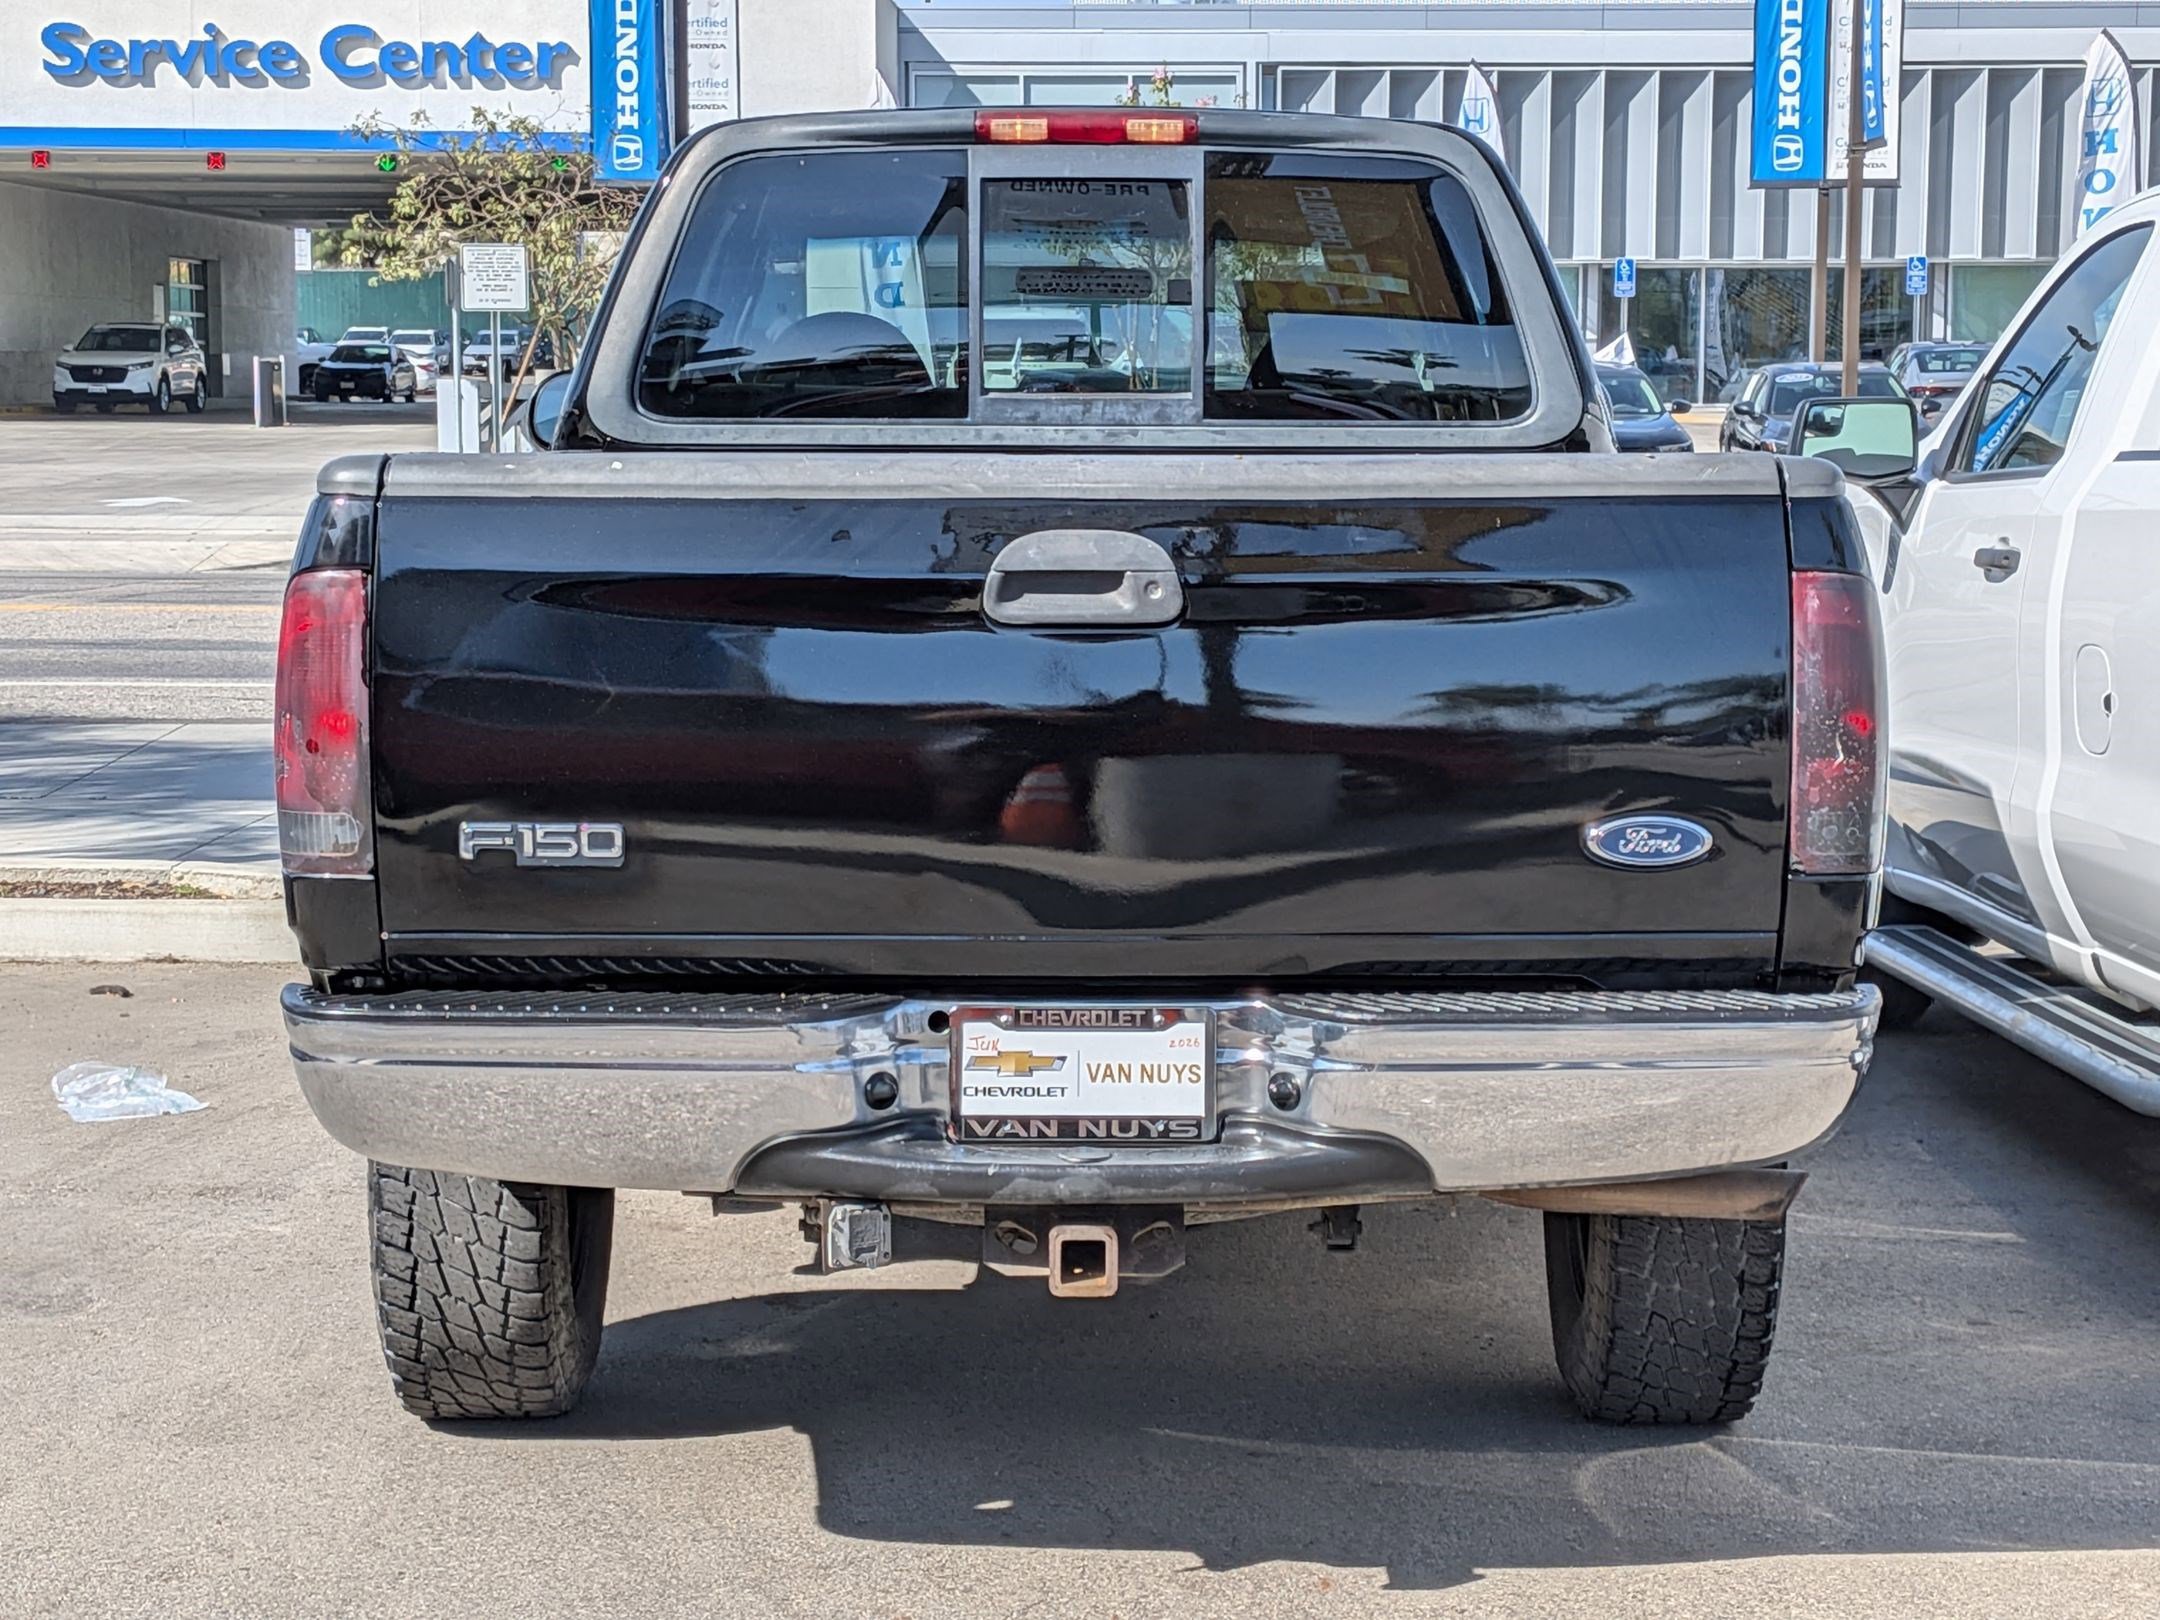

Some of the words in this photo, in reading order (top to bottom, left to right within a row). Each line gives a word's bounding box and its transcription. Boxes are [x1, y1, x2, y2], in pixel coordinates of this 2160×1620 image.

[688, 16, 728, 28] rtified
[40, 21, 300, 79] Service
[319, 23, 567, 80] Center
[688, 77, 729, 89] rtified
[459, 821, 625, 867] F-150
[1618, 827, 1682, 853] Ford
[1018, 1009, 1147, 1027] CHEVROLET
[1168, 1037, 1201, 1049] 2026
[1086, 1062, 1132, 1084] VAN
[1140, 1062, 1201, 1084] NUYS
[963, 1086, 1068, 1098] CHEVROLET
[966, 1118, 1057, 1138] VAN
[1077, 1118, 1199, 1138] NUYS
